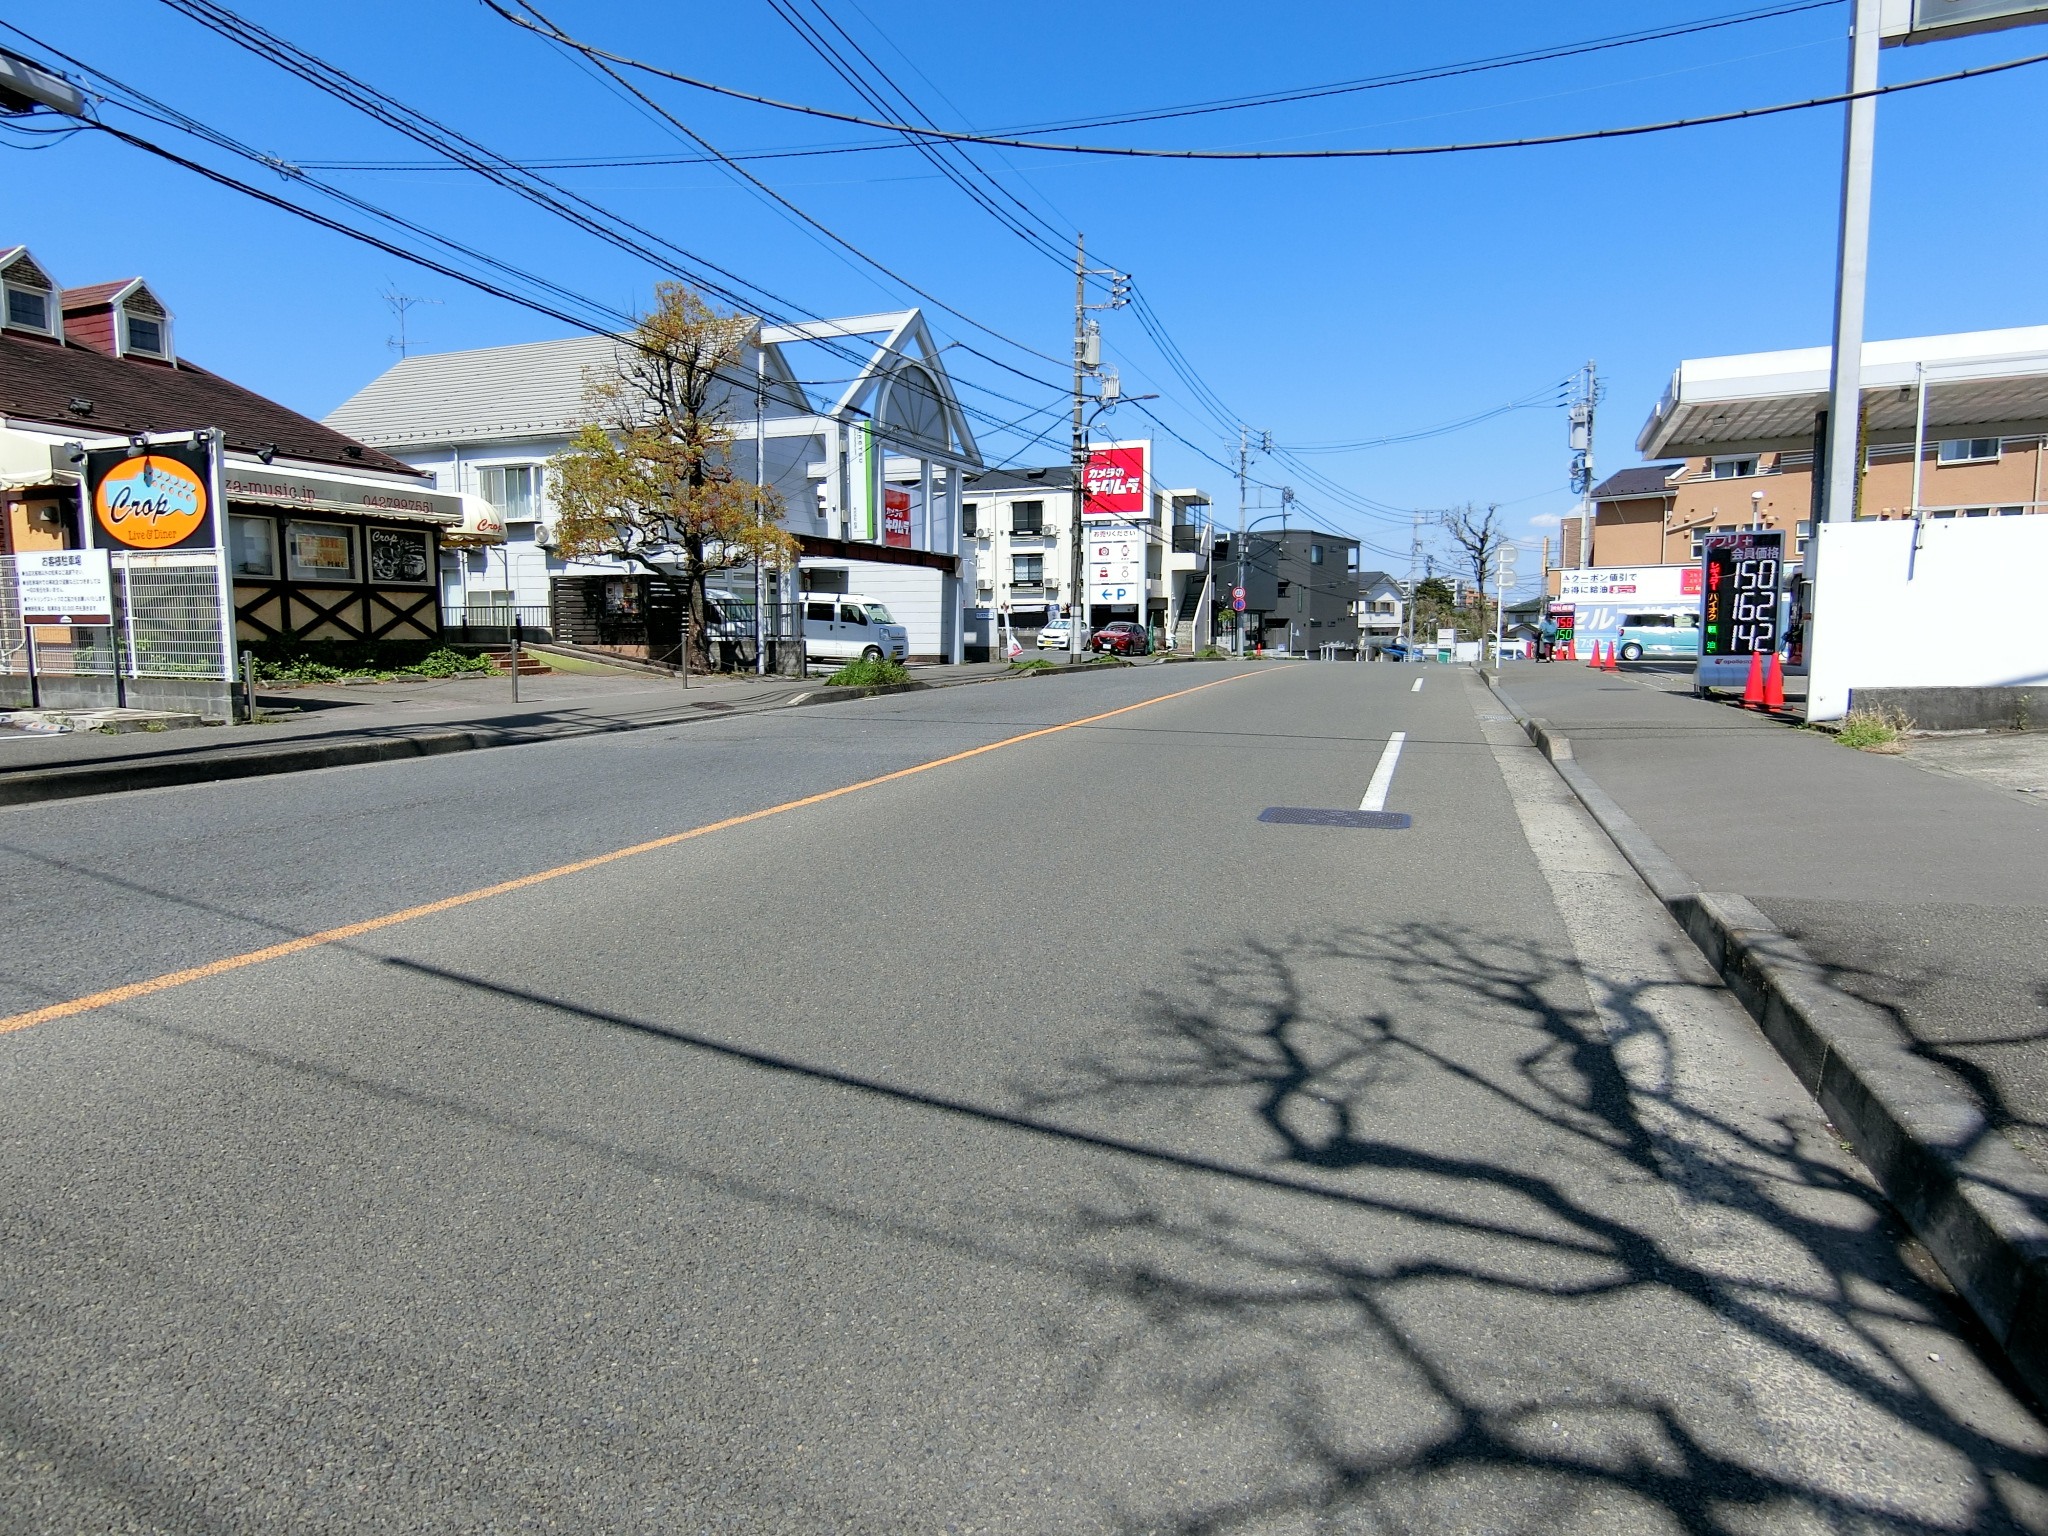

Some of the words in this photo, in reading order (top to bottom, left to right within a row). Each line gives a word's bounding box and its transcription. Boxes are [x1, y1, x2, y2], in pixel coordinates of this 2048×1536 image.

[1088, 468, 1124, 478] カメラの
[1087, 478, 1140, 495] キタムラ
[110, 486, 170, 525] Crop
[128, 530, 146, 540] Live
[155, 529, 177, 539] Diner
[372, 531, 398, 545] Crop
[1732, 547, 1779, 560] 会員価格
[1708, 562, 1719, 590] レギュラー
[1734, 560, 1776, 589] 150
[1117, 589, 1126, 600] P
[1708, 593, 1718, 621] ハイオク
[1732, 592, 1775, 620] 162
[1557, 617, 1573, 628] 158
[1556, 630, 1572, 640] 150
[1731, 623, 1773, 651] 142
